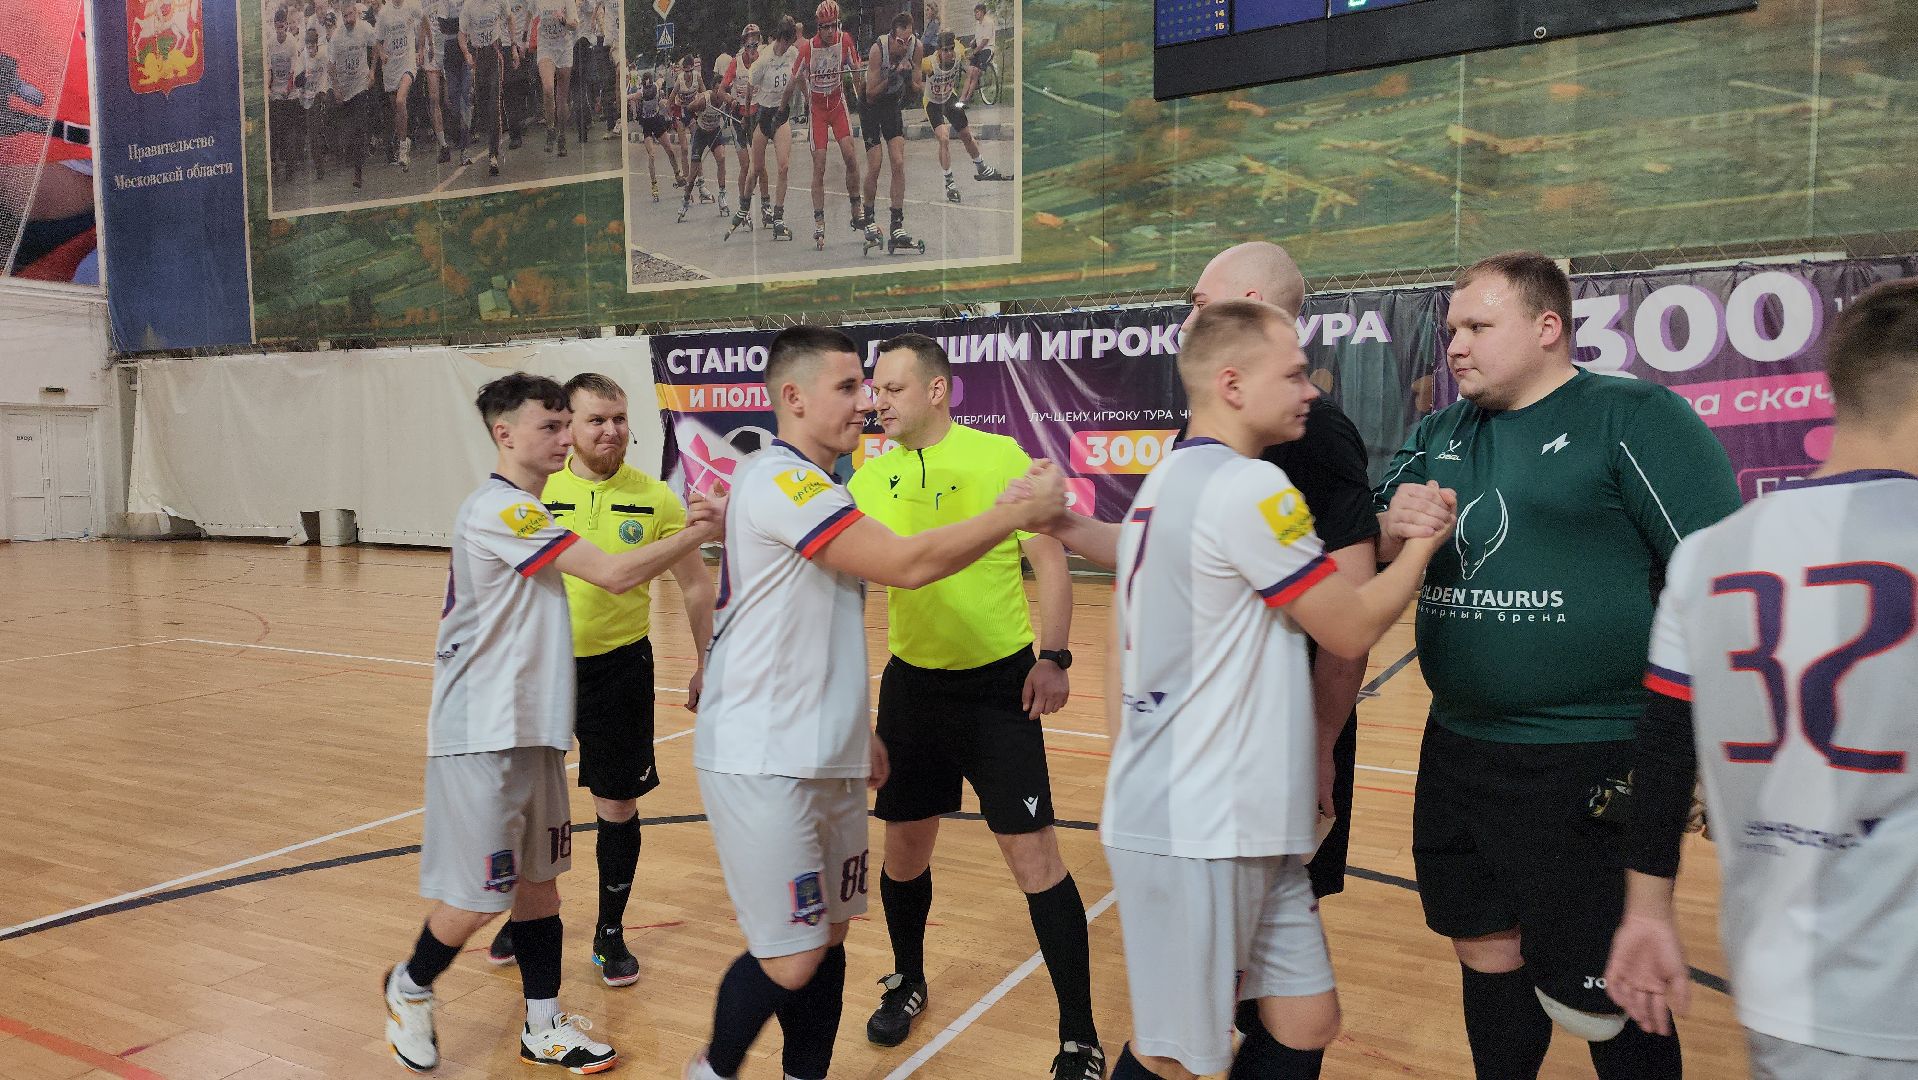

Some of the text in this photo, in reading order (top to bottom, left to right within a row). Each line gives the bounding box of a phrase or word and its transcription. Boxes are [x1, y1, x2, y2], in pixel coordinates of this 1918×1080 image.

[128, 136, 215, 162] Правительство
[114, 163, 234, 190] Московской области
[666, 345, 770, 375] СТАНО
[1041, 323, 1187, 361] ИГРОК
[1295, 310, 1393, 348] УРА
[689, 386, 772, 408] И ПОЛУ
[1734, 384, 1837, 413] скач
[950, 414, 1006, 425] УПЕРЛИГИ
[1029, 410, 1091, 423] ЛУЧШЕМУ
[1093, 410, 1141, 422] ИГРОКУ
[1142, 409, 1174, 421] ТУРА
[1420, 584, 1564, 608] OLDEN TAURUS
[1498, 612, 1566, 623] бренд
[1707, 560, 1917, 774] 32
[1583, 975, 1608, 990] JO
